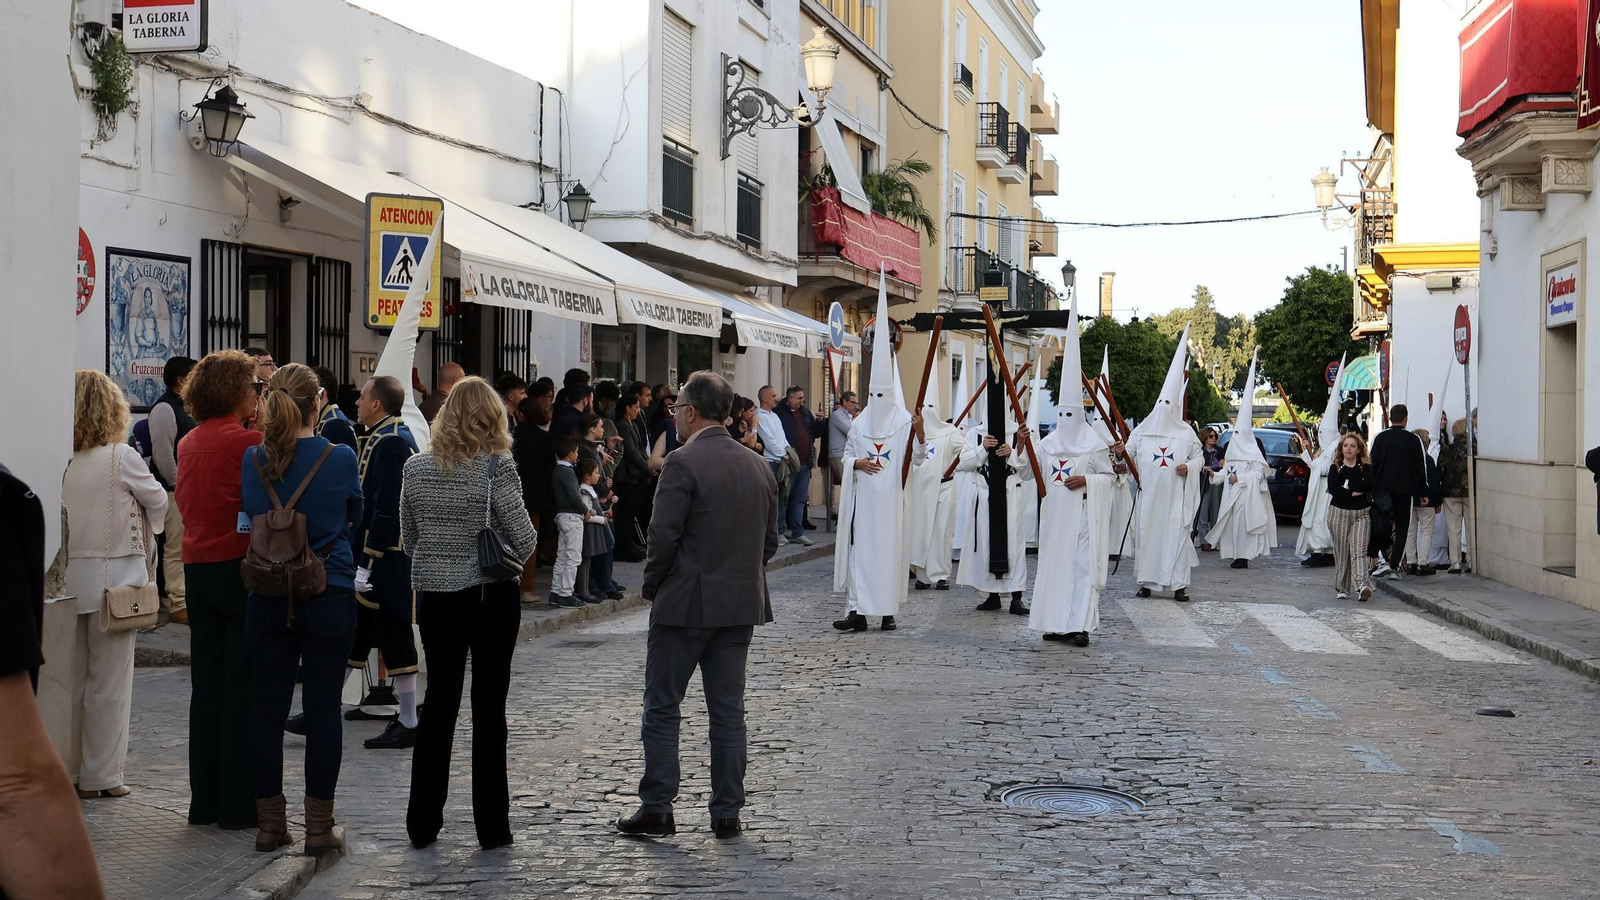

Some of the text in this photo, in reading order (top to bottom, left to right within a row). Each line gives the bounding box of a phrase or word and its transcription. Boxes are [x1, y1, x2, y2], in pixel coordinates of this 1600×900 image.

[129, 11, 190, 24] LA GLORIA
[133, 26, 186, 38] TABERNA
[380, 207, 433, 226] ATENCIÓN
[131, 264, 169, 288] LA GLORIA
[480, 273, 604, 316] LA GLORIA TABERNA
[378, 298, 432, 318] PEATES
[630, 299, 714, 329] LA GLORIA TABERNA
[131, 361, 165, 378] Cruzcamp
